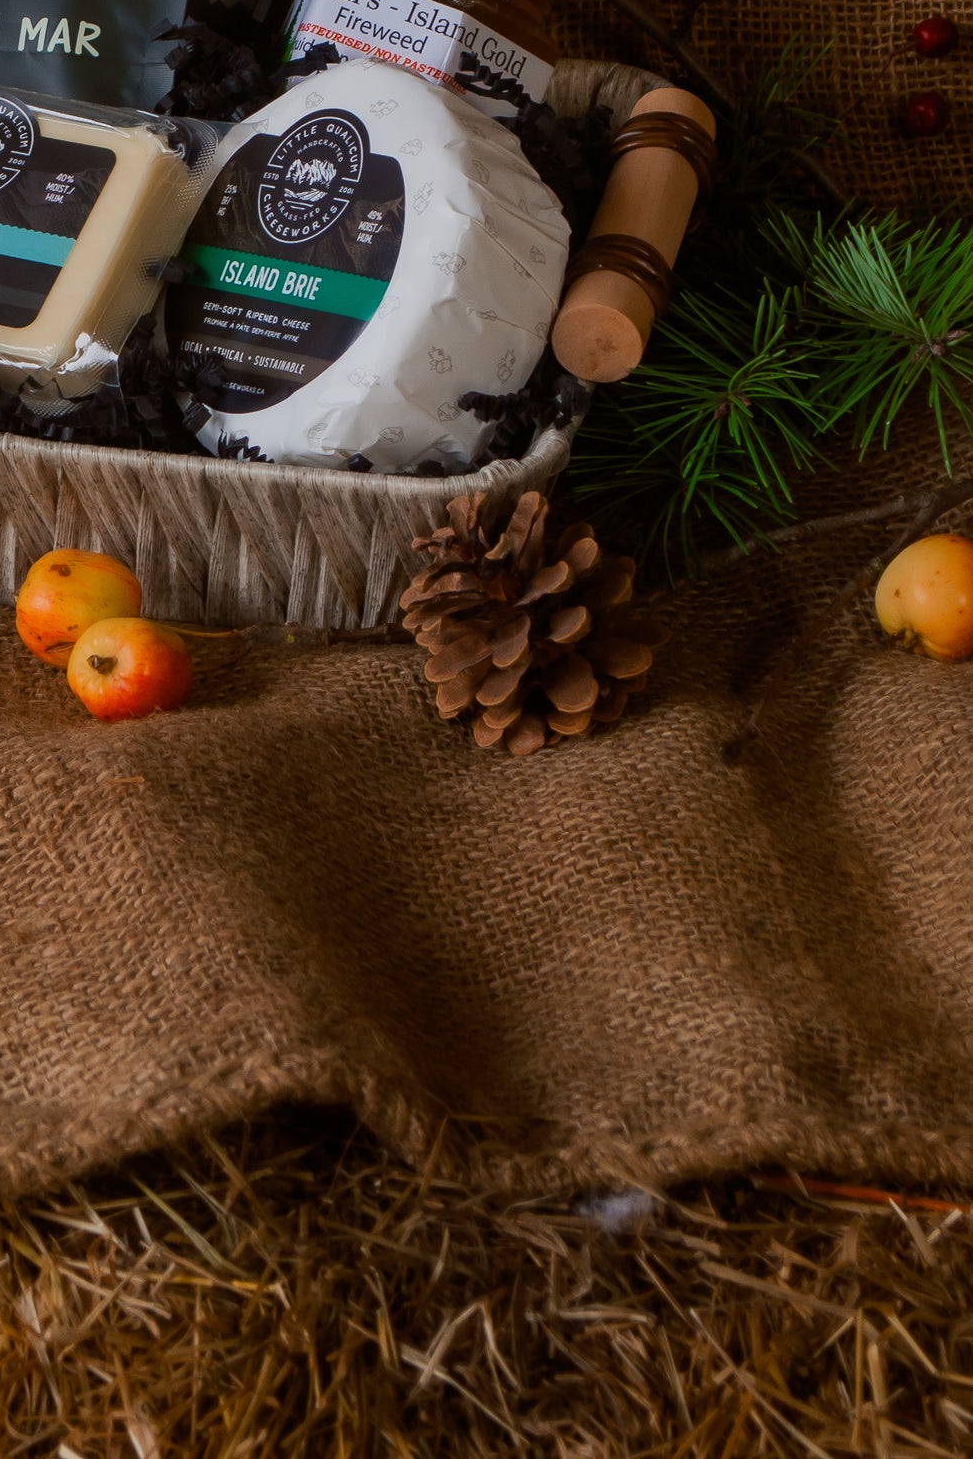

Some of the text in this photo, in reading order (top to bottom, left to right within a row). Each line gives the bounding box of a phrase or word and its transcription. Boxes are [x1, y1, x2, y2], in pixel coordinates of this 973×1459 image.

[17, 17, 102, 58] MAR
[334, 6, 429, 55] Fireweed
[405, 1, 480, 51] Island
[481, 36, 527, 79] Gold
[7, 157, 26, 166] 2001
[277, 123, 359, 174] LITTLE QUALICUM
[297, 139, 344, 163] HANDCRAFTED
[55, 173, 75, 183] 40%
[263, 171, 355, 195] ESTD 2001
[263, 193, 339, 237] CHEESEWORKS
[277, 201, 321, 221] GRASS-FED
[220, 259, 323, 300] ISLAND BRIE
[203, 301, 311, 331] SEMI-SOFT RIPENED CHEESE
[180, 339, 203, 354] LOCAL
[253, 355, 306, 375] SUSTAINABLE
